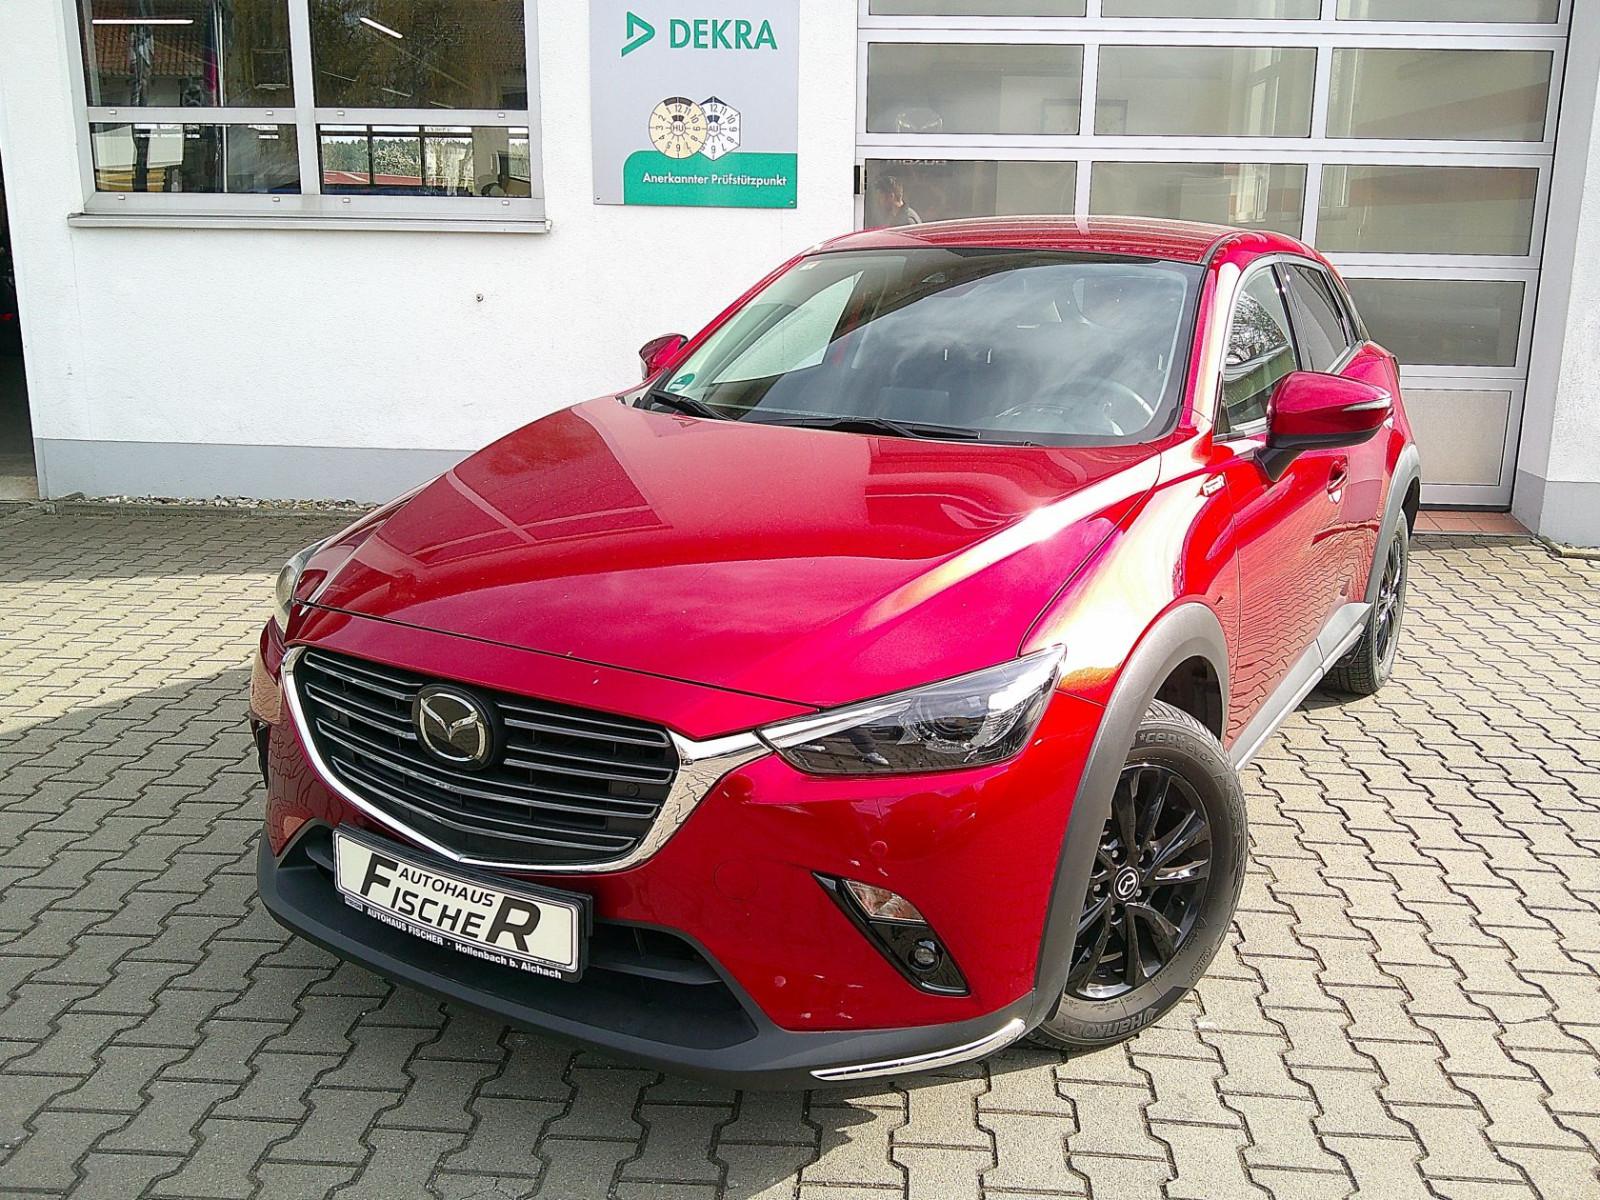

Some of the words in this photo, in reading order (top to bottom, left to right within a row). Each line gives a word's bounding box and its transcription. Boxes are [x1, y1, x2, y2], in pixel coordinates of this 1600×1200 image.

[669, 19, 778, 50] DEKRA
[675, 104, 683, 113] 12
[683, 106, 692, 115] 11
[710, 103, 718, 113] 12
[720, 106, 728, 116] 11
[690, 114, 699, 124] 10
[726, 114, 736, 125] 10
[642, 172, 709, 185] Anerkannter
[711, 173, 787, 188] Prüfstützpunkt
[398, 867, 496, 908] AUTOHAUS
[359, 852, 542, 953] FISCHER
[366, 907, 407, 932] AUTOHAUS
[408, 925, 444, 946] FISCHER
[455, 942, 507, 966] Hollenbach
[509, 957, 519, 969] b.
[521, 962, 562, 980] Aichach
